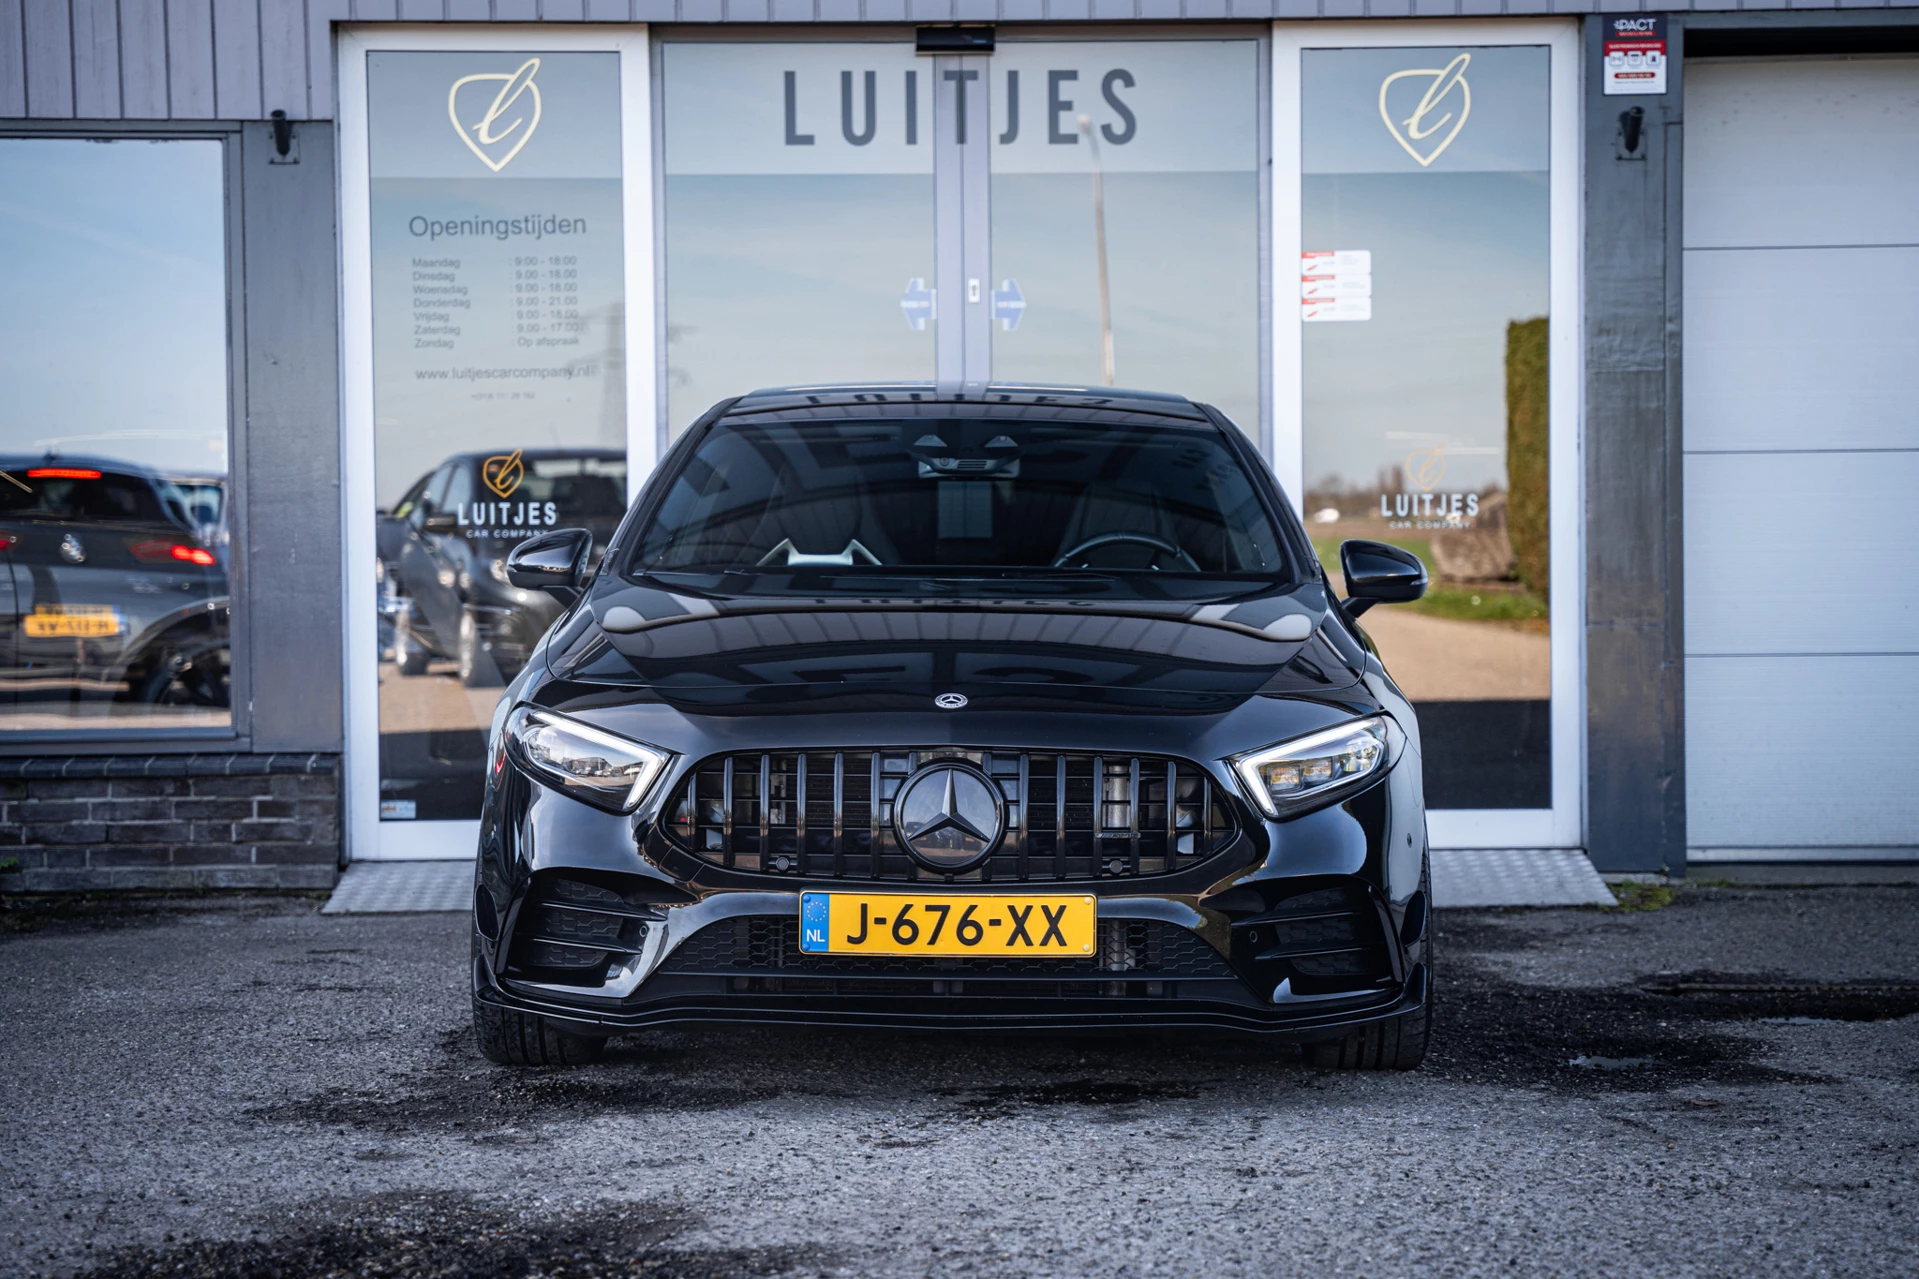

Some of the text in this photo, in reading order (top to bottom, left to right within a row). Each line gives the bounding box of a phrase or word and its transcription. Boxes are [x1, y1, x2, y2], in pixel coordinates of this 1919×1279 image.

[784, 68, 1137, 146] LUITJES
[409, 215, 587, 241] Openingstijden
[412, 258, 461, 270] Maandag
[412, 271, 455, 283] Dinsdag
[413, 285, 468, 296] Woensdag
[413, 298, 471, 309] Donderdag
[413, 311, 450, 323] Vrijdag
[414, 325, 461, 336] Zaterdag
[414, 338, 454, 350] Zondag
[517, 336, 533, 347] Op
[415, 365, 590, 382] www.luitjescarcompany.nl
[1381, 493, 1479, 517] LUITJES
[457, 502, 557, 526] LUITJES
[1389, 521, 1412, 529] CAR
[466, 529, 489, 539] CAR
[807, 903, 1067, 946] NL J-676-XX
